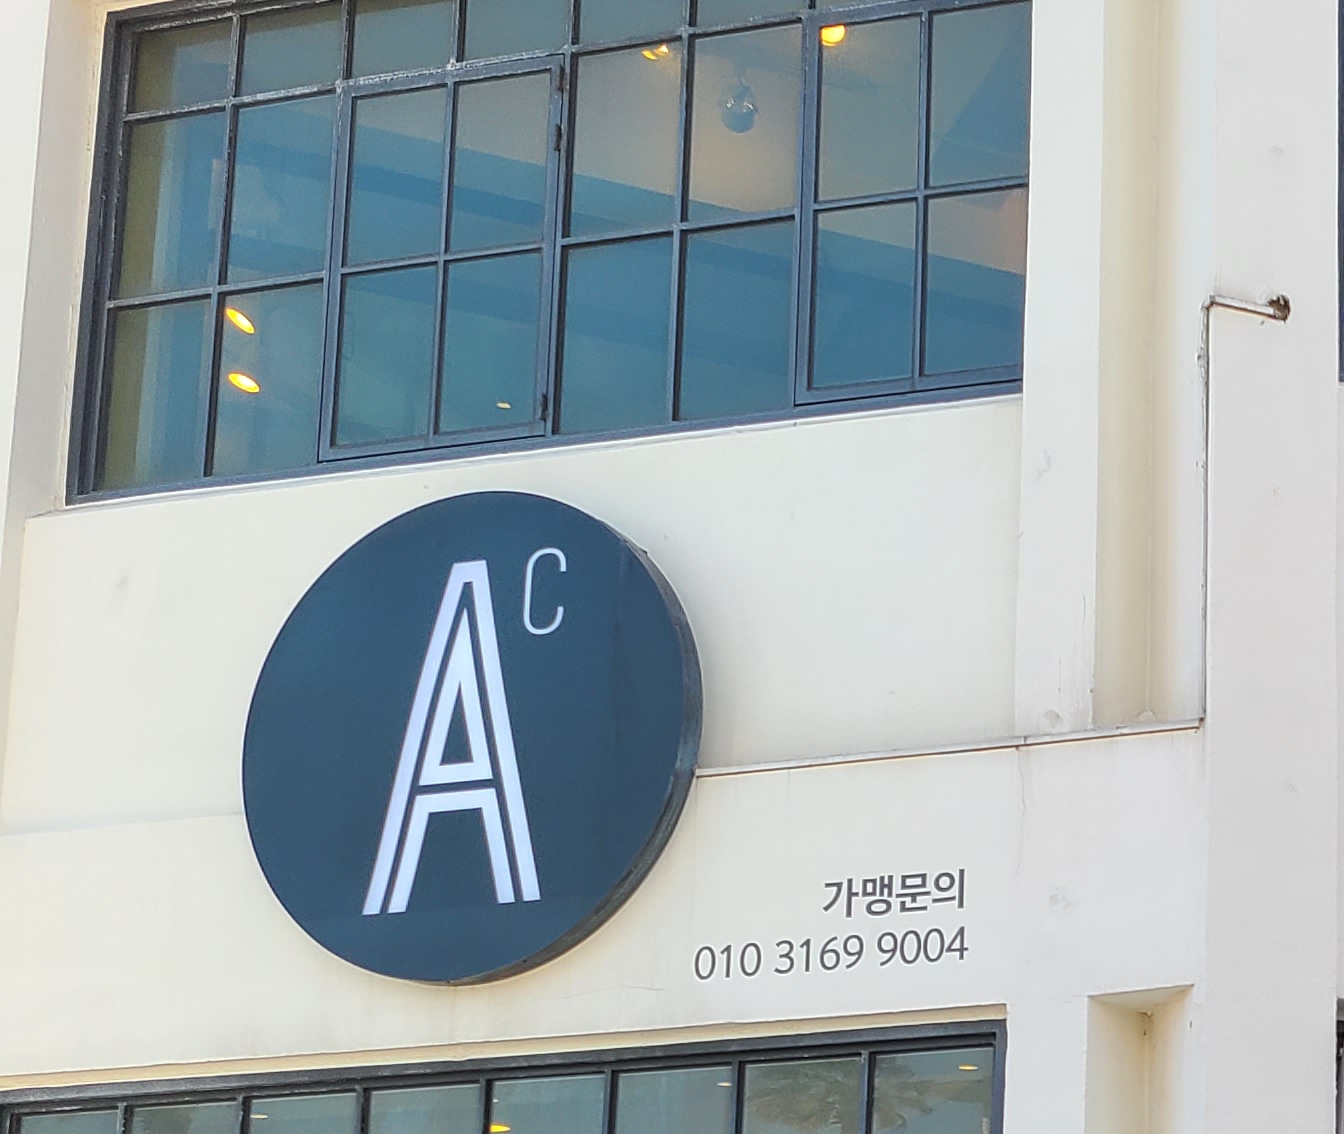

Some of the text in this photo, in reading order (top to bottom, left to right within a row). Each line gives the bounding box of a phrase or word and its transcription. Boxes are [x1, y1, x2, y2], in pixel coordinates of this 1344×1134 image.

[822, 868, 966, 918] 가맹문의
[694, 926, 969, 980] 010 3169 9004
